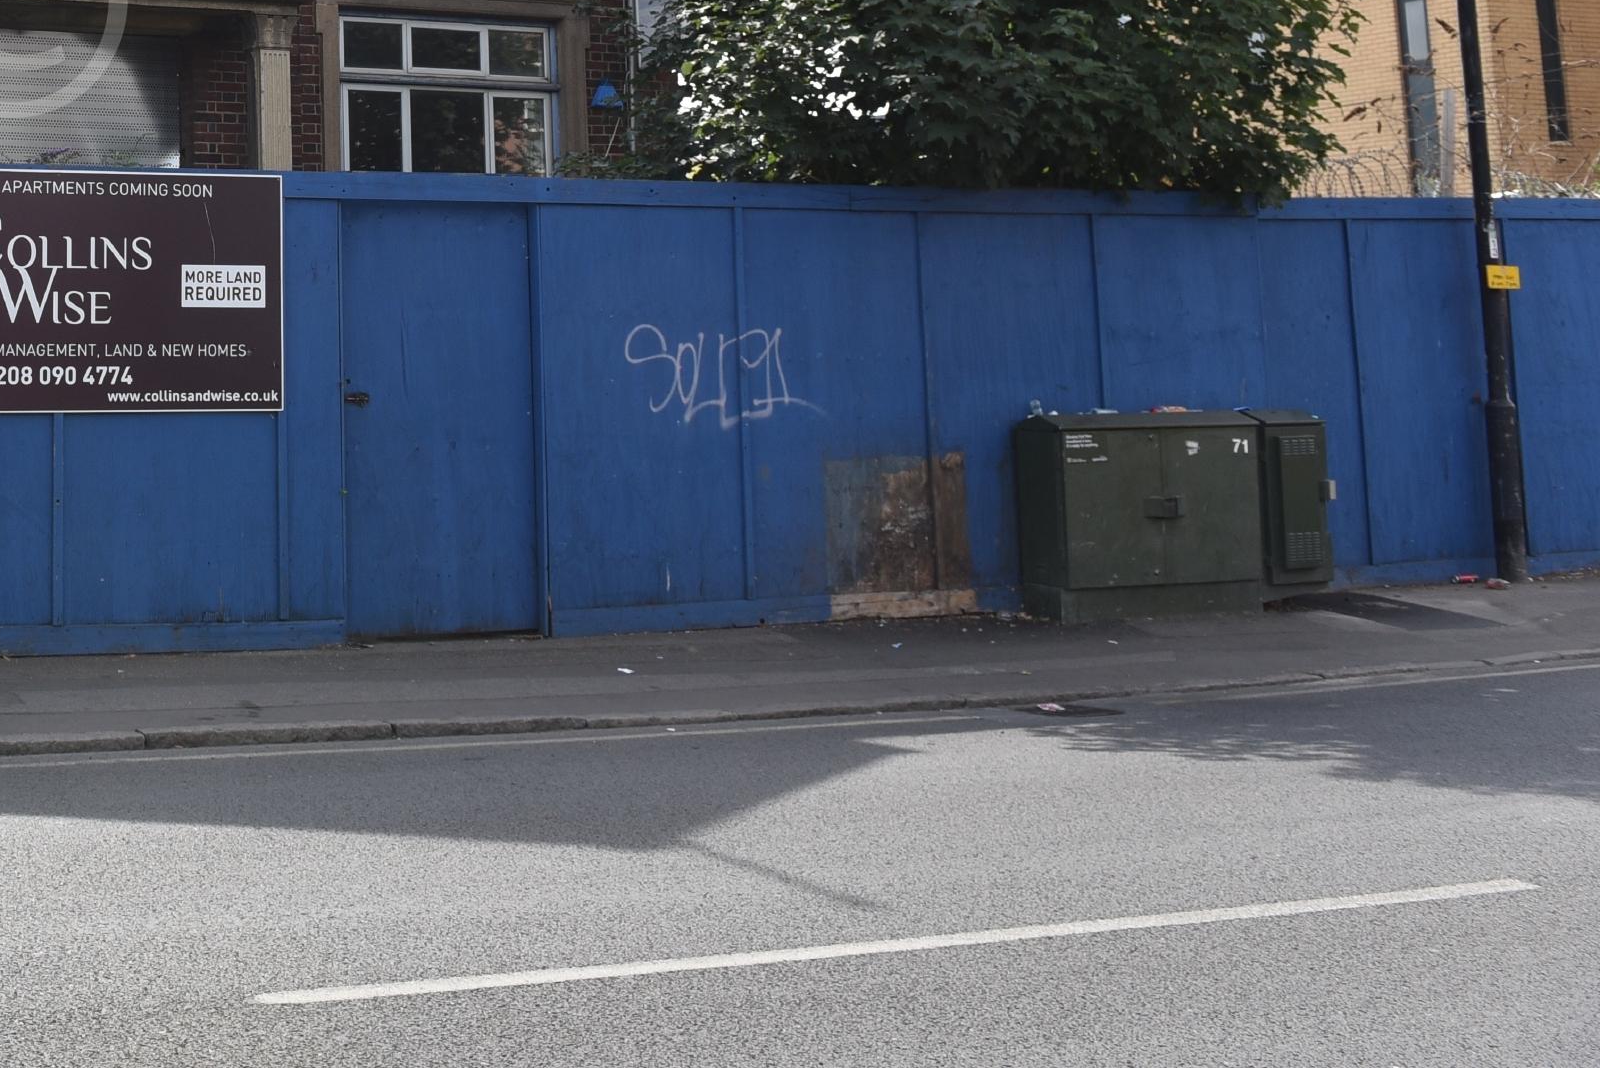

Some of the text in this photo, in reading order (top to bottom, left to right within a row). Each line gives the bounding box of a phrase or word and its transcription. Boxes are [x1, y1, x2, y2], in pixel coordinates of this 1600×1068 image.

[2, 180, 105, 196] APARTMENTS
[109, 182, 168, 197] COMING
[173, 184, 214, 198] SOON
[185, 270, 262, 284] MORE LAND
[184, 286, 262, 302] REQUIRED
[104, 343, 143, 357] LAND
[147, 343, 157, 357] &
[162, 343, 194, 357] NEW
[198, 343, 247, 358] HOMES
[39, 365, 77, 385] 090
[82, 365, 133, 385] 4774
[107, 389, 279, 402] www.collinsandwise.co.uk
[1231, 438, 1249, 454] 71
